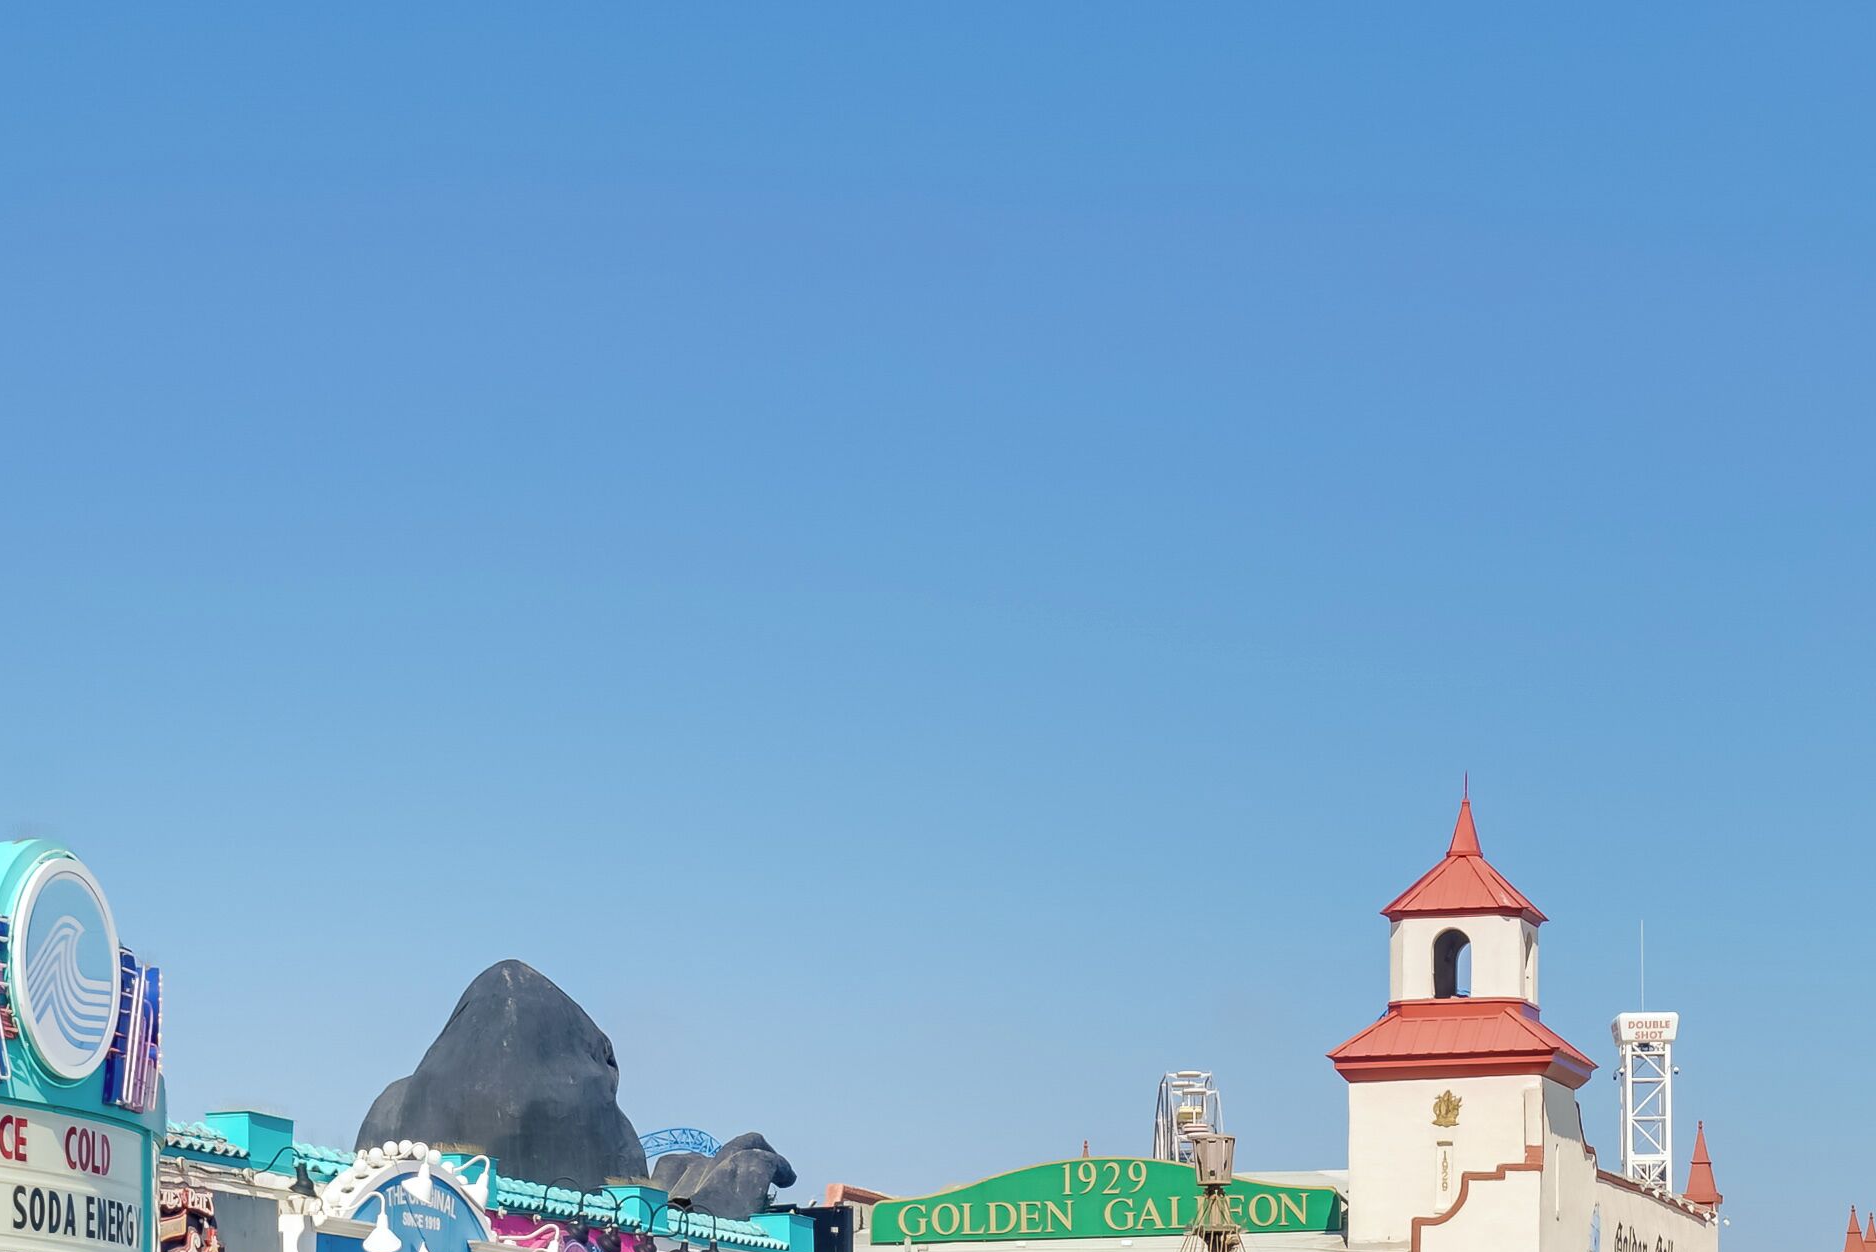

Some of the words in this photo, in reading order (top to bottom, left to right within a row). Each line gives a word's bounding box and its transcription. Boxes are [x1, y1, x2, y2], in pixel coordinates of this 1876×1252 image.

[1628, 1020, 1671, 1030] DOUBLE
[1634, 1031, 1664, 1040] SHOT
[65, 1126, 111, 1176] COLD
[1061, 1162, 1147, 1195] 1929
[386, 1187, 407, 1207] THE
[13, 1185, 77, 1236] SODA
[86, 1196, 142, 1249] ENERGY
[402, 1213, 423, 1229] SINCE
[424, 1217, 441, 1232] 1919
[898, 1201, 1074, 1236] GOLDEN
[1104, 1193, 1308, 1231] GALEON
